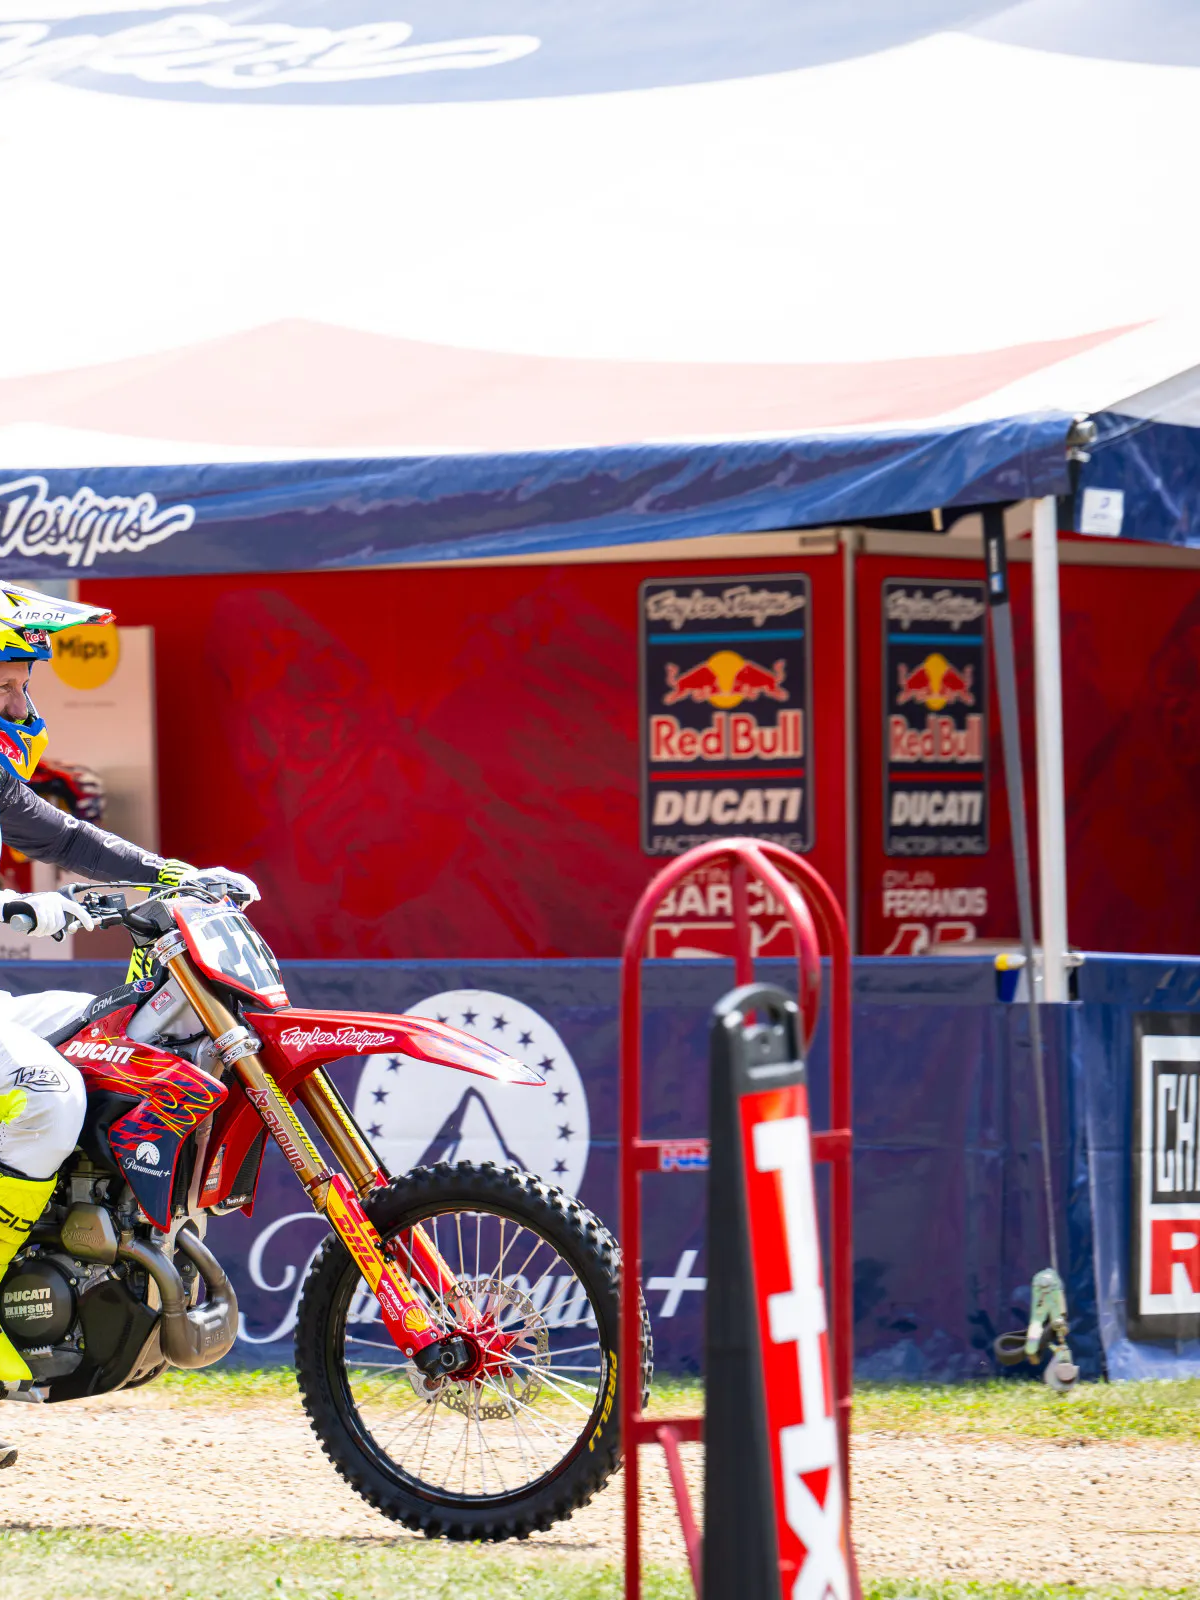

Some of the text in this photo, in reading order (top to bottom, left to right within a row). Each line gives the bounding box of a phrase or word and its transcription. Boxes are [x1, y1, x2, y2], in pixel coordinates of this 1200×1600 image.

[12, 609, 66, 622] AIROH
[57, 634, 108, 662] Mips
[650, 709, 803, 762] Red Bull
[889, 714, 983, 763] Red Bull
[652, 787, 803, 825] DUCATI
[890, 791, 983, 827] DUCATI
[882, 887, 986, 918] FERRANDIS
[63, 1041, 136, 1064] DUCATI
[280, 1026, 395, 1052] Troy Lee Designs
[261, 1109, 307, 1173] SHOWA
[1157, 1073, 1200, 1193] CH
[122, 1157, 171, 1178] Paramount+
[335, 1213, 376, 1271] DHL
[3, 1287, 51, 1304] DUCATI
[5, 1302, 53, 1316] HINSON
[588, 1348, 618, 1453] PIRELLI
